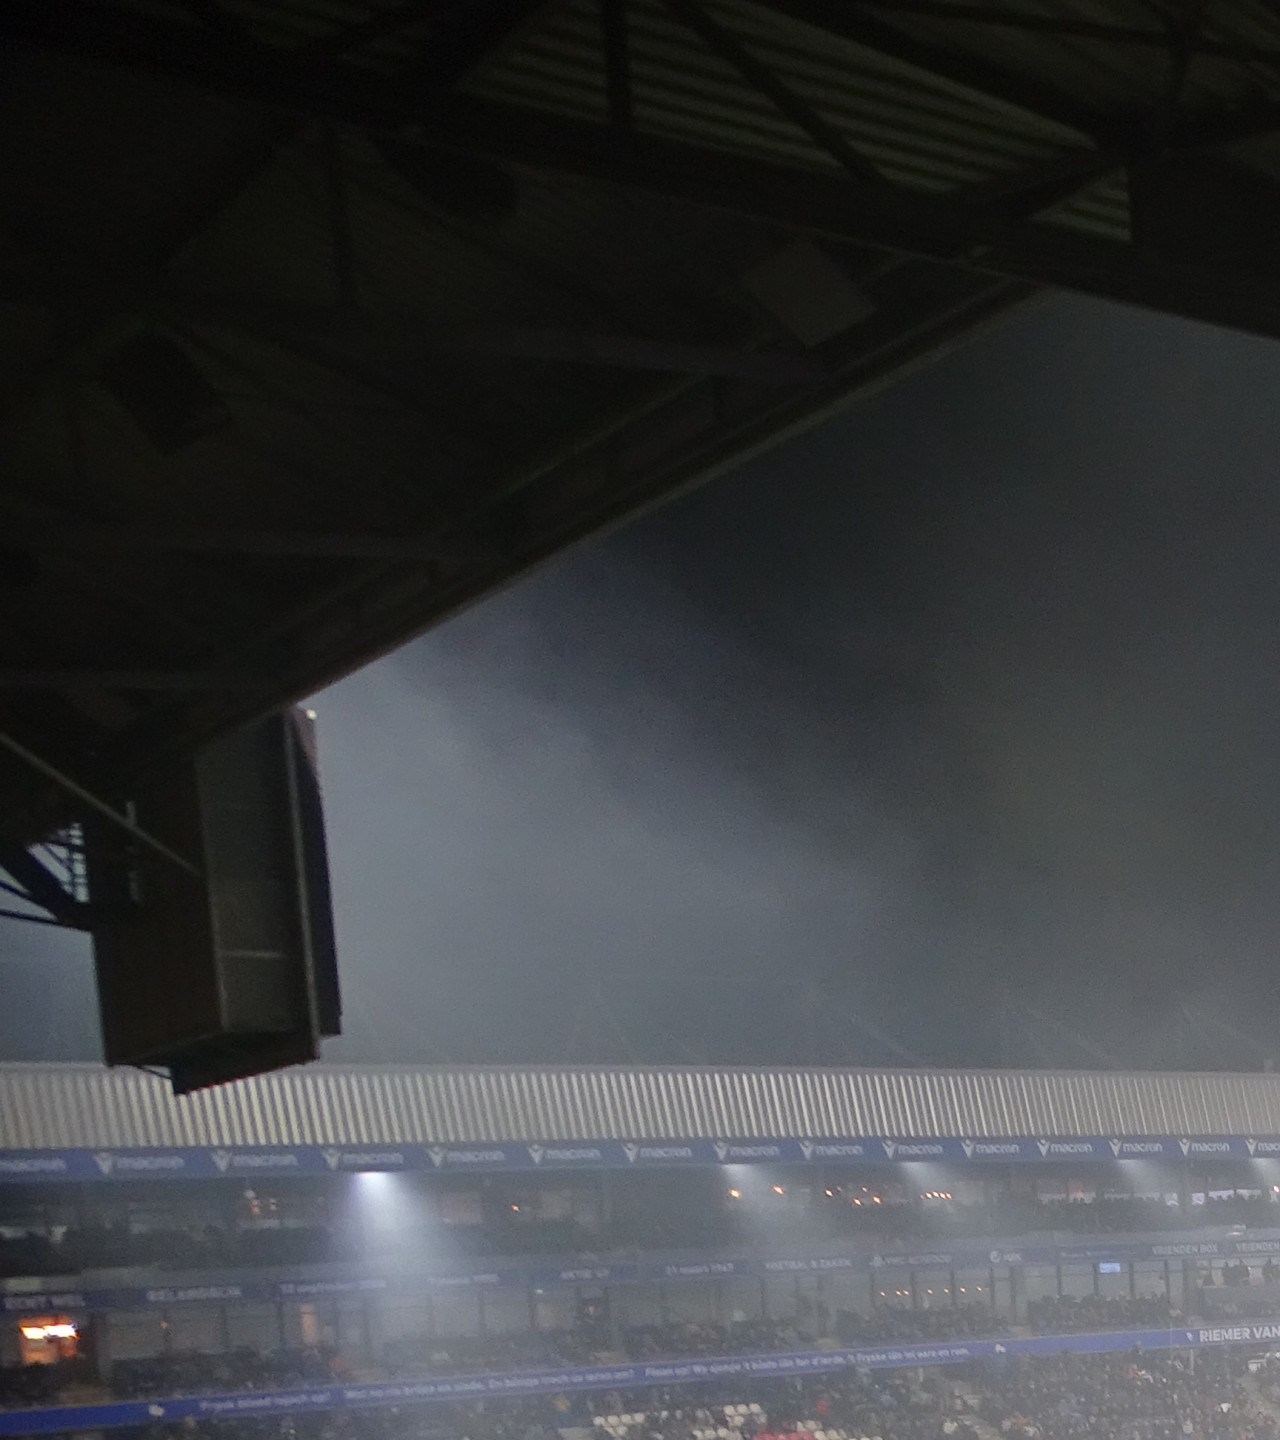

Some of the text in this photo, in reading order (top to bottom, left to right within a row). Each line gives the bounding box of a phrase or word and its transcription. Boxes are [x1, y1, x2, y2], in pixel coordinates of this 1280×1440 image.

[730, 1144, 780, 1157] macron
[816, 1143, 863, 1155] macron
[897, 1143, 943, 1154] macron
[976, 1143, 1019, 1154] macron
[1050, 1142, 1092, 1153] macron
[1122, 1142, 1163, 1153] macron
[1192, 1141, 1230, 1152] macron
[1152, 1243, 1218, 1255] VRIENDEN BOX
[1236, 1241, 1279, 1252] VRIENDEN
[1200, 1327, 1249, 1342] RIEMER
[1253, 1325, 1280, 1340] VAN
